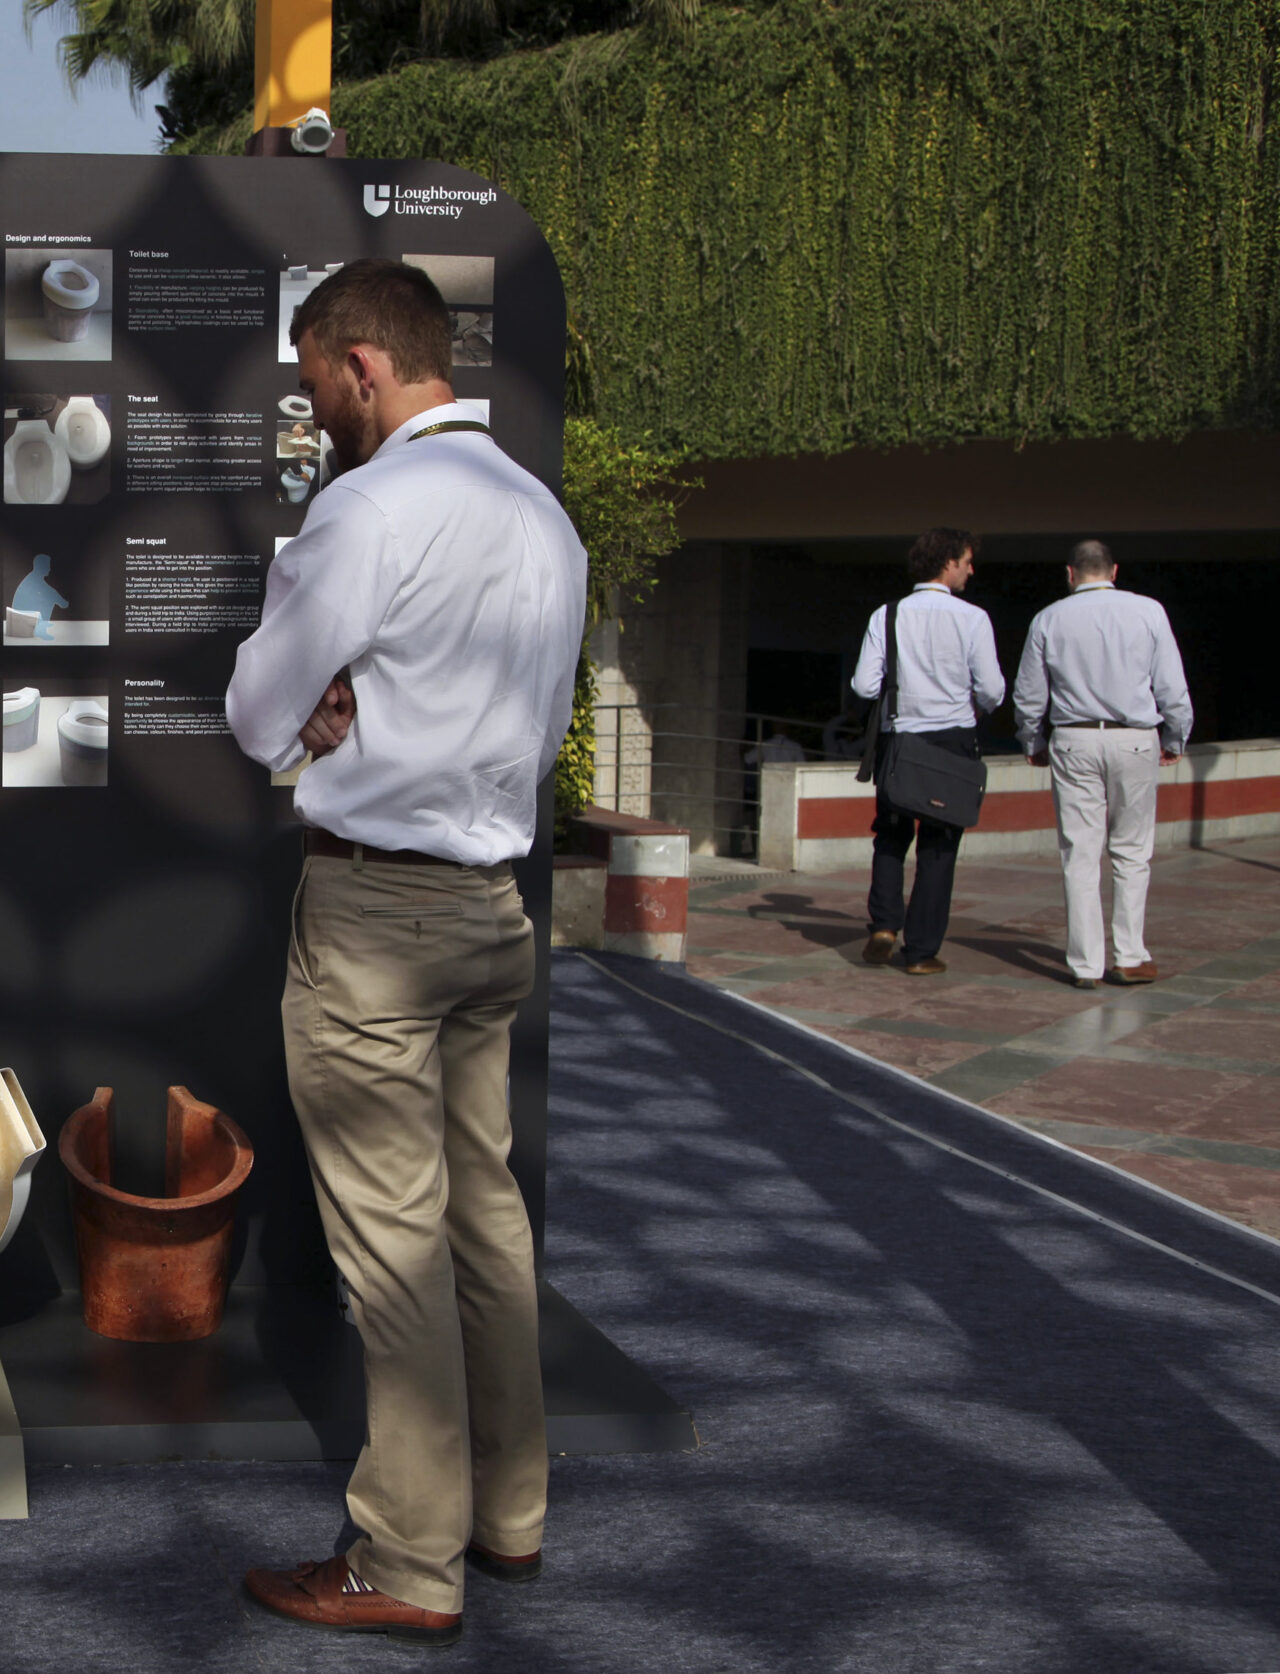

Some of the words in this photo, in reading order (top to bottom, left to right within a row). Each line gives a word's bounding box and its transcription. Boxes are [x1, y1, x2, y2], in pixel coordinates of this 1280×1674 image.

[395, 185, 496, 205] Loughborough
[395, 201, 463, 219] University
[6, 234, 31, 243] Design
[48, 235, 91, 243] ergonomics
[125, 679, 165, 688] Personality
